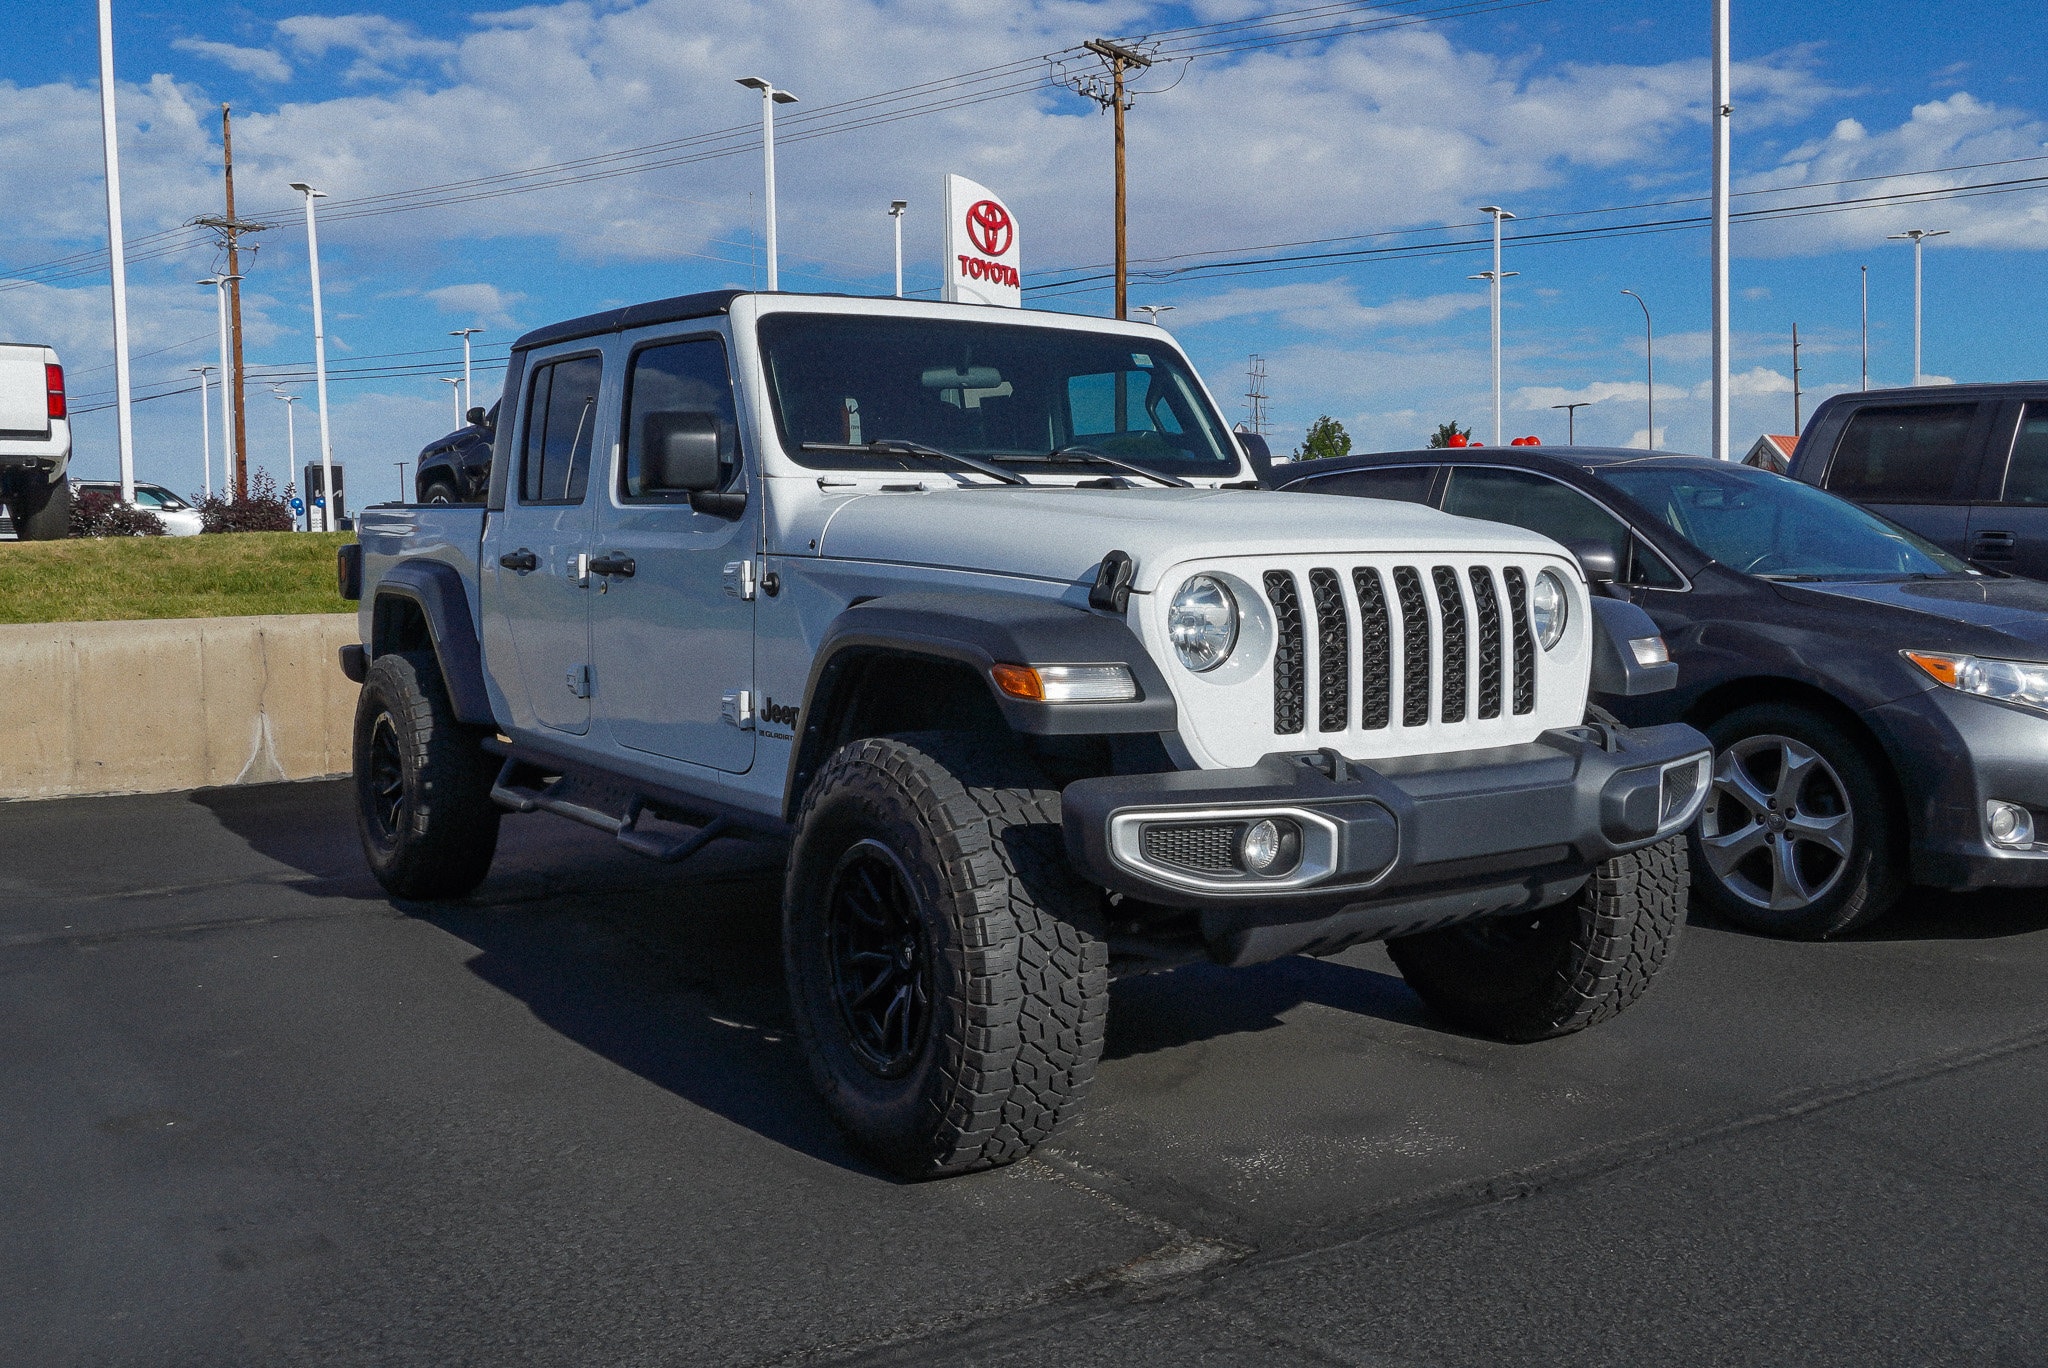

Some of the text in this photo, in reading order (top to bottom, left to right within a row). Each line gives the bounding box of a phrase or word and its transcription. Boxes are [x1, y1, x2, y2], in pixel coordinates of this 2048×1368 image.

[958, 255, 1020, 289] TOYOTA
[761, 697, 800, 731] Jeep
[765, 730, 794, 741] GLADIAT
